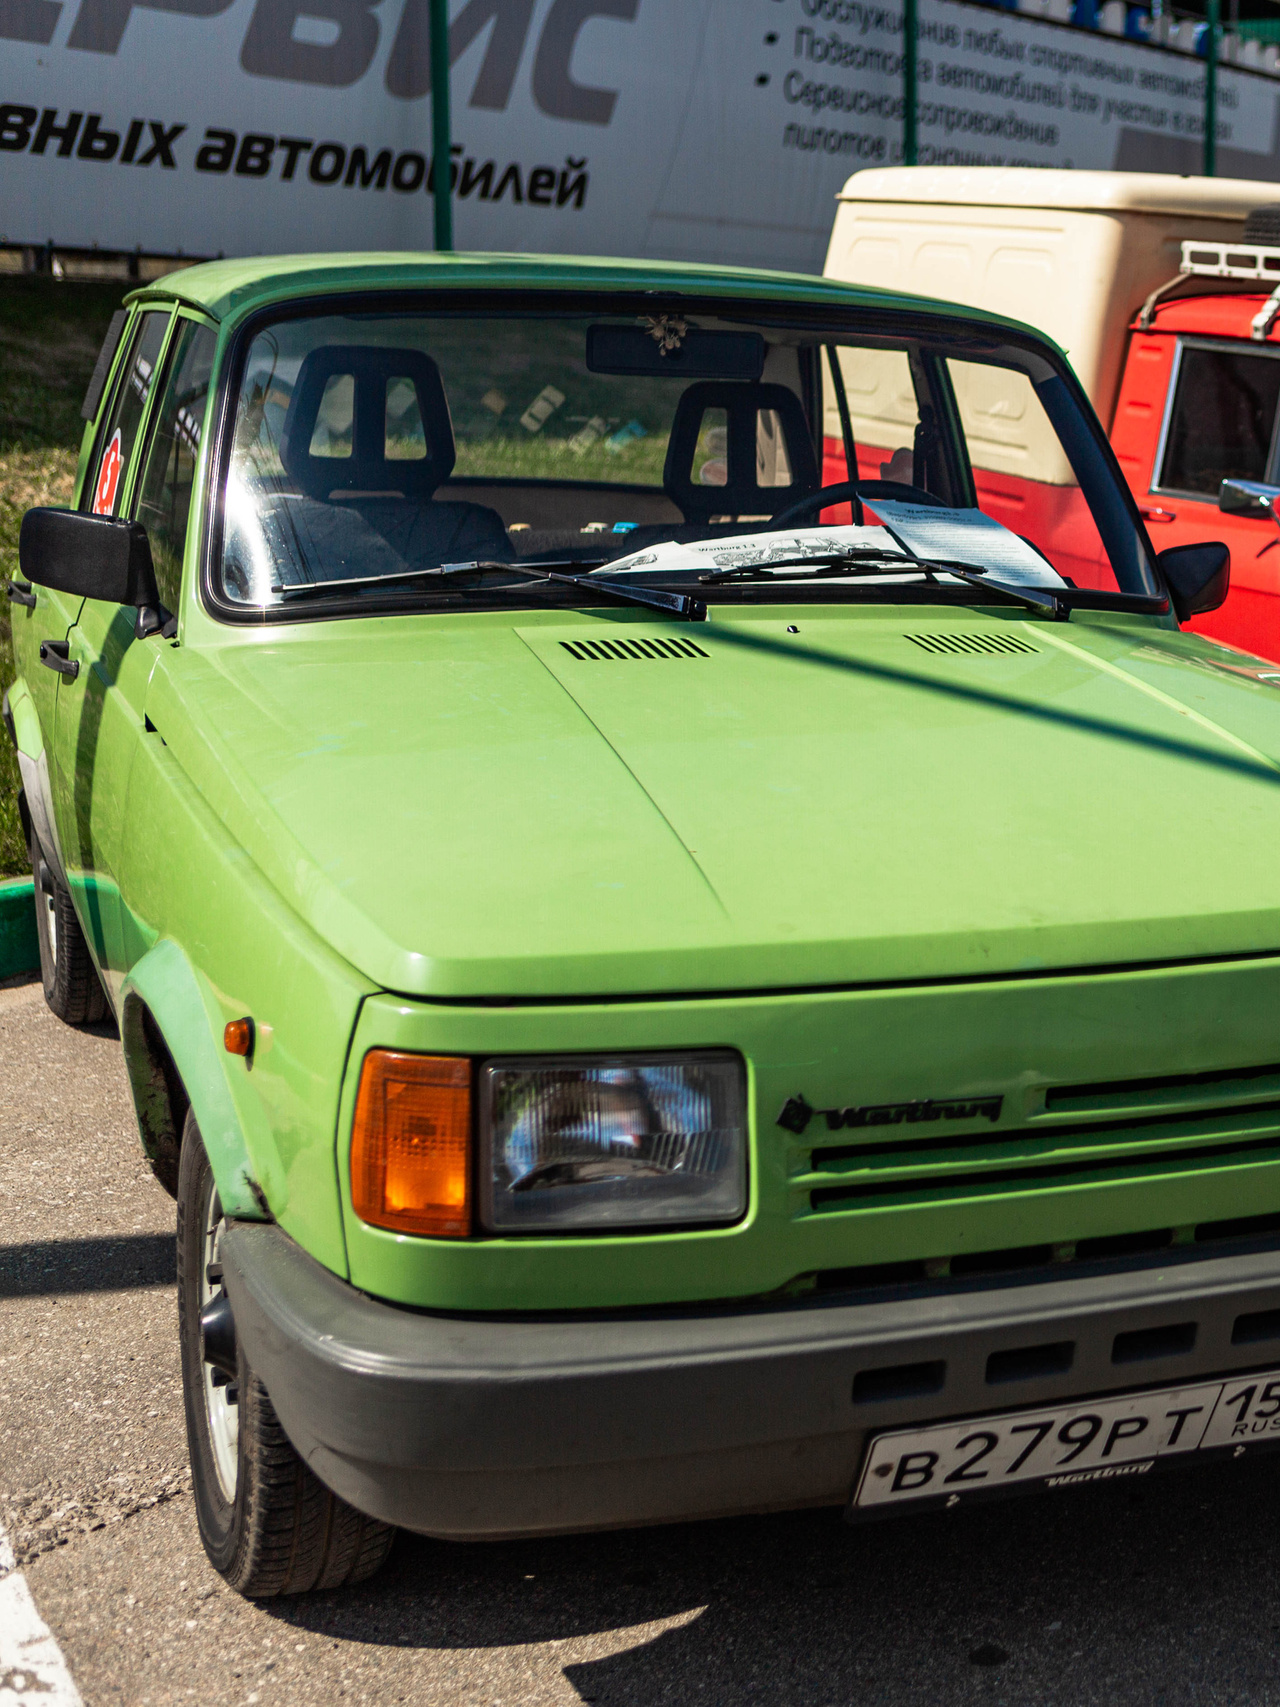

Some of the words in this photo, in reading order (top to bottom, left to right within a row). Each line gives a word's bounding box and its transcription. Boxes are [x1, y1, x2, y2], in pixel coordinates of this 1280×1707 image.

[935, 61, 1066, 109] автомобилей
[783, 122, 887, 162] пилотов
[916, 101, 1060, 148] опровождение
[816, 1094, 1005, 1131] Wartburg
[890, 1404, 1204, 1493] В279РТ
[1044, 1460, 1155, 1488] Wartburg
